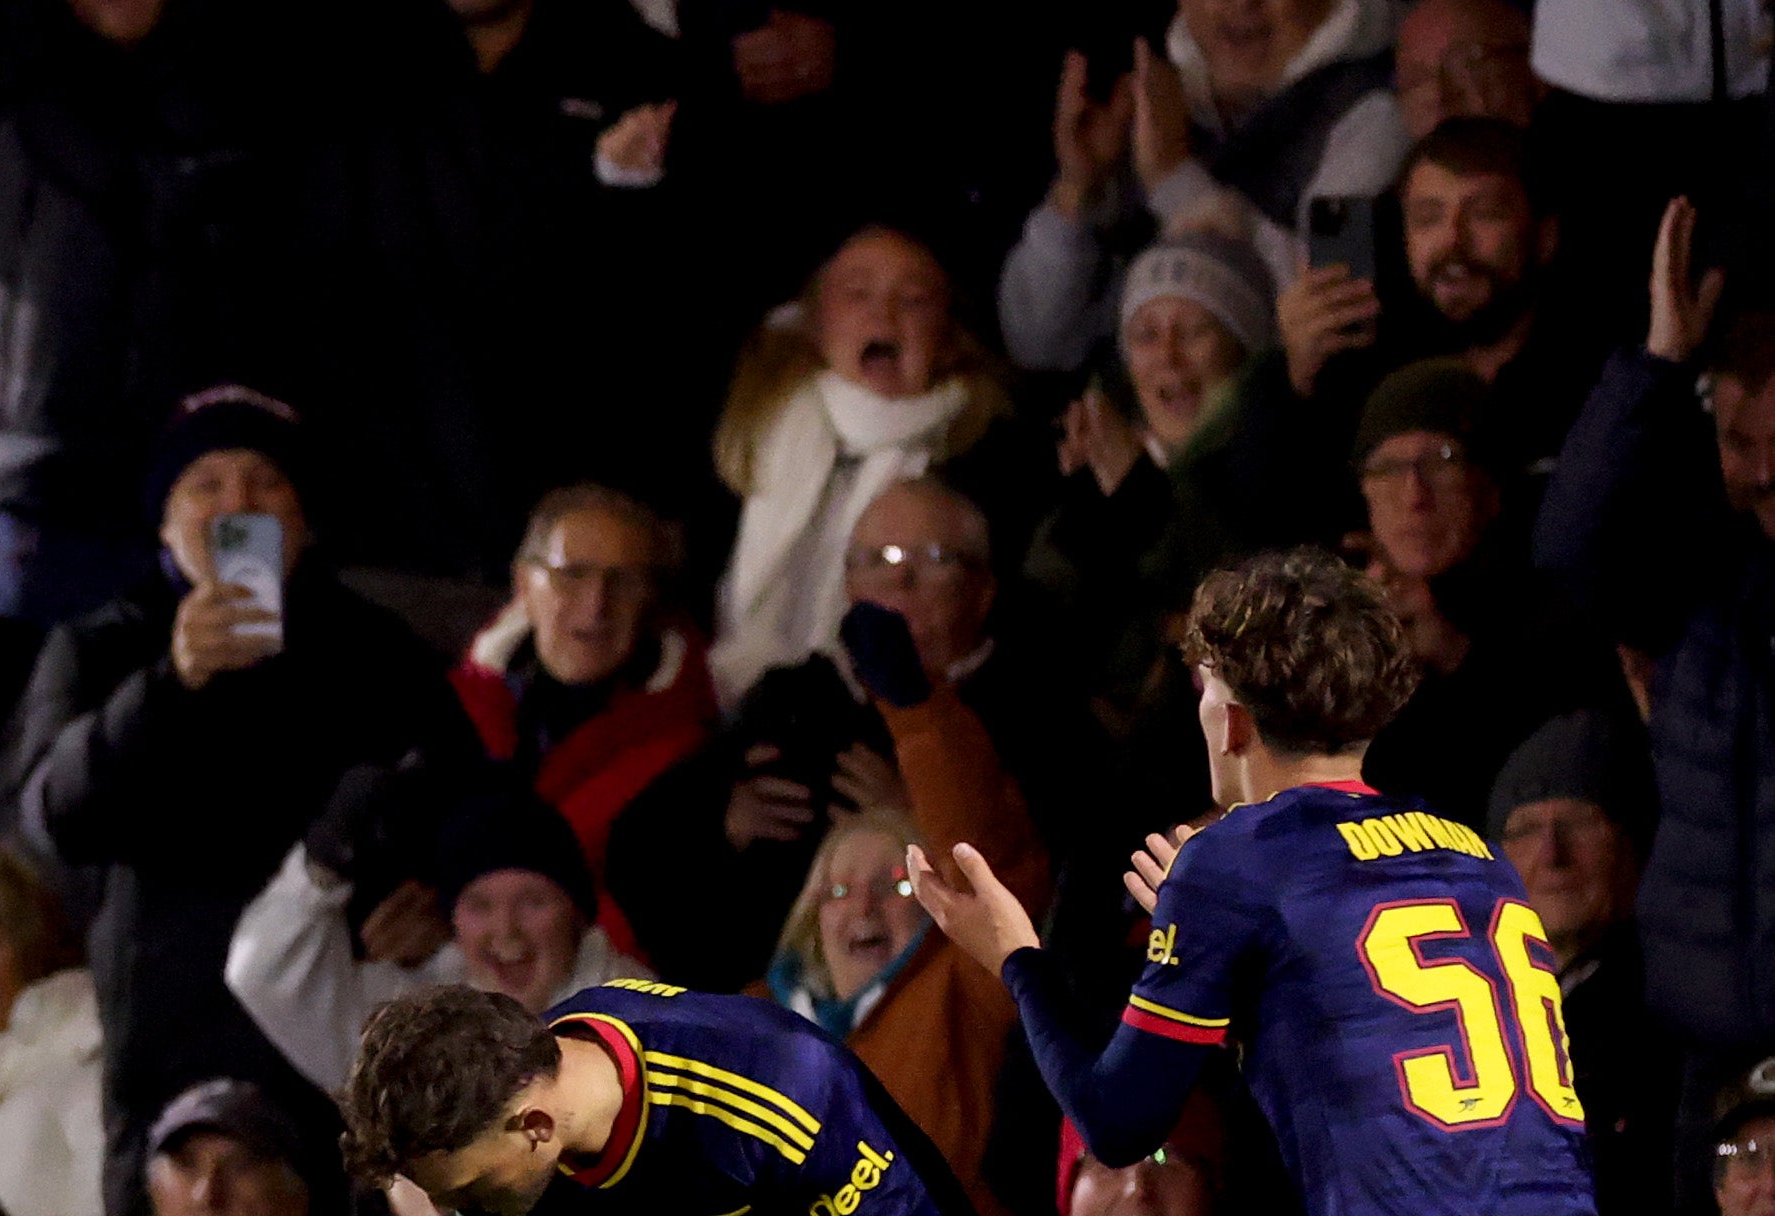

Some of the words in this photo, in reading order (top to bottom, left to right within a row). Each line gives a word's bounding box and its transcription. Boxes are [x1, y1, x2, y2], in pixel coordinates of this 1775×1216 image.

[1336, 811, 1494, 861] DOWMAN
[1147, 923, 1179, 966] el.
[1355, 897, 1585, 1133] 56
